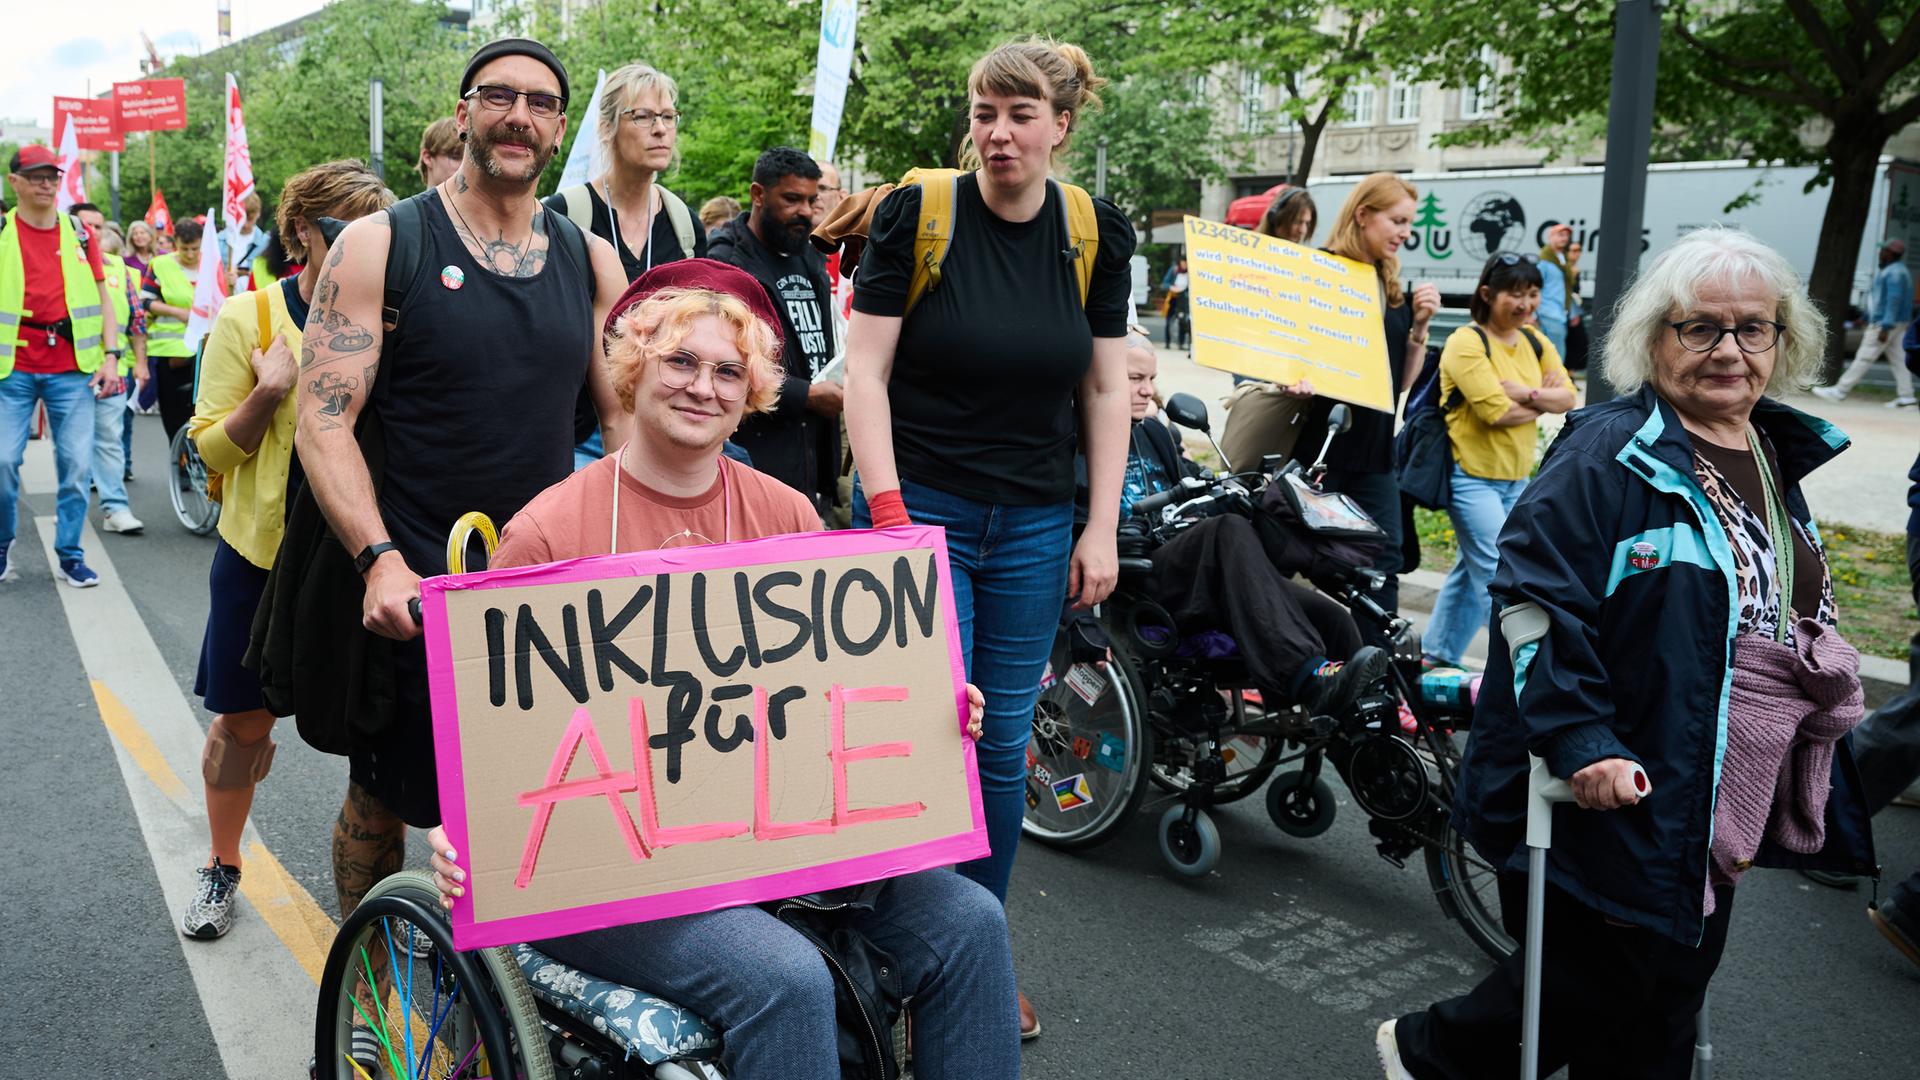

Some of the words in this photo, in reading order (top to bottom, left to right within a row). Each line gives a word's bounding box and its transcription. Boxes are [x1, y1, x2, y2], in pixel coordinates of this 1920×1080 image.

[1196, 250, 1222, 261] wird
[1197, 270, 1223, 284] wird
[485, 553, 938, 711] INKLUSION
[513, 683, 928, 889] ALLE
